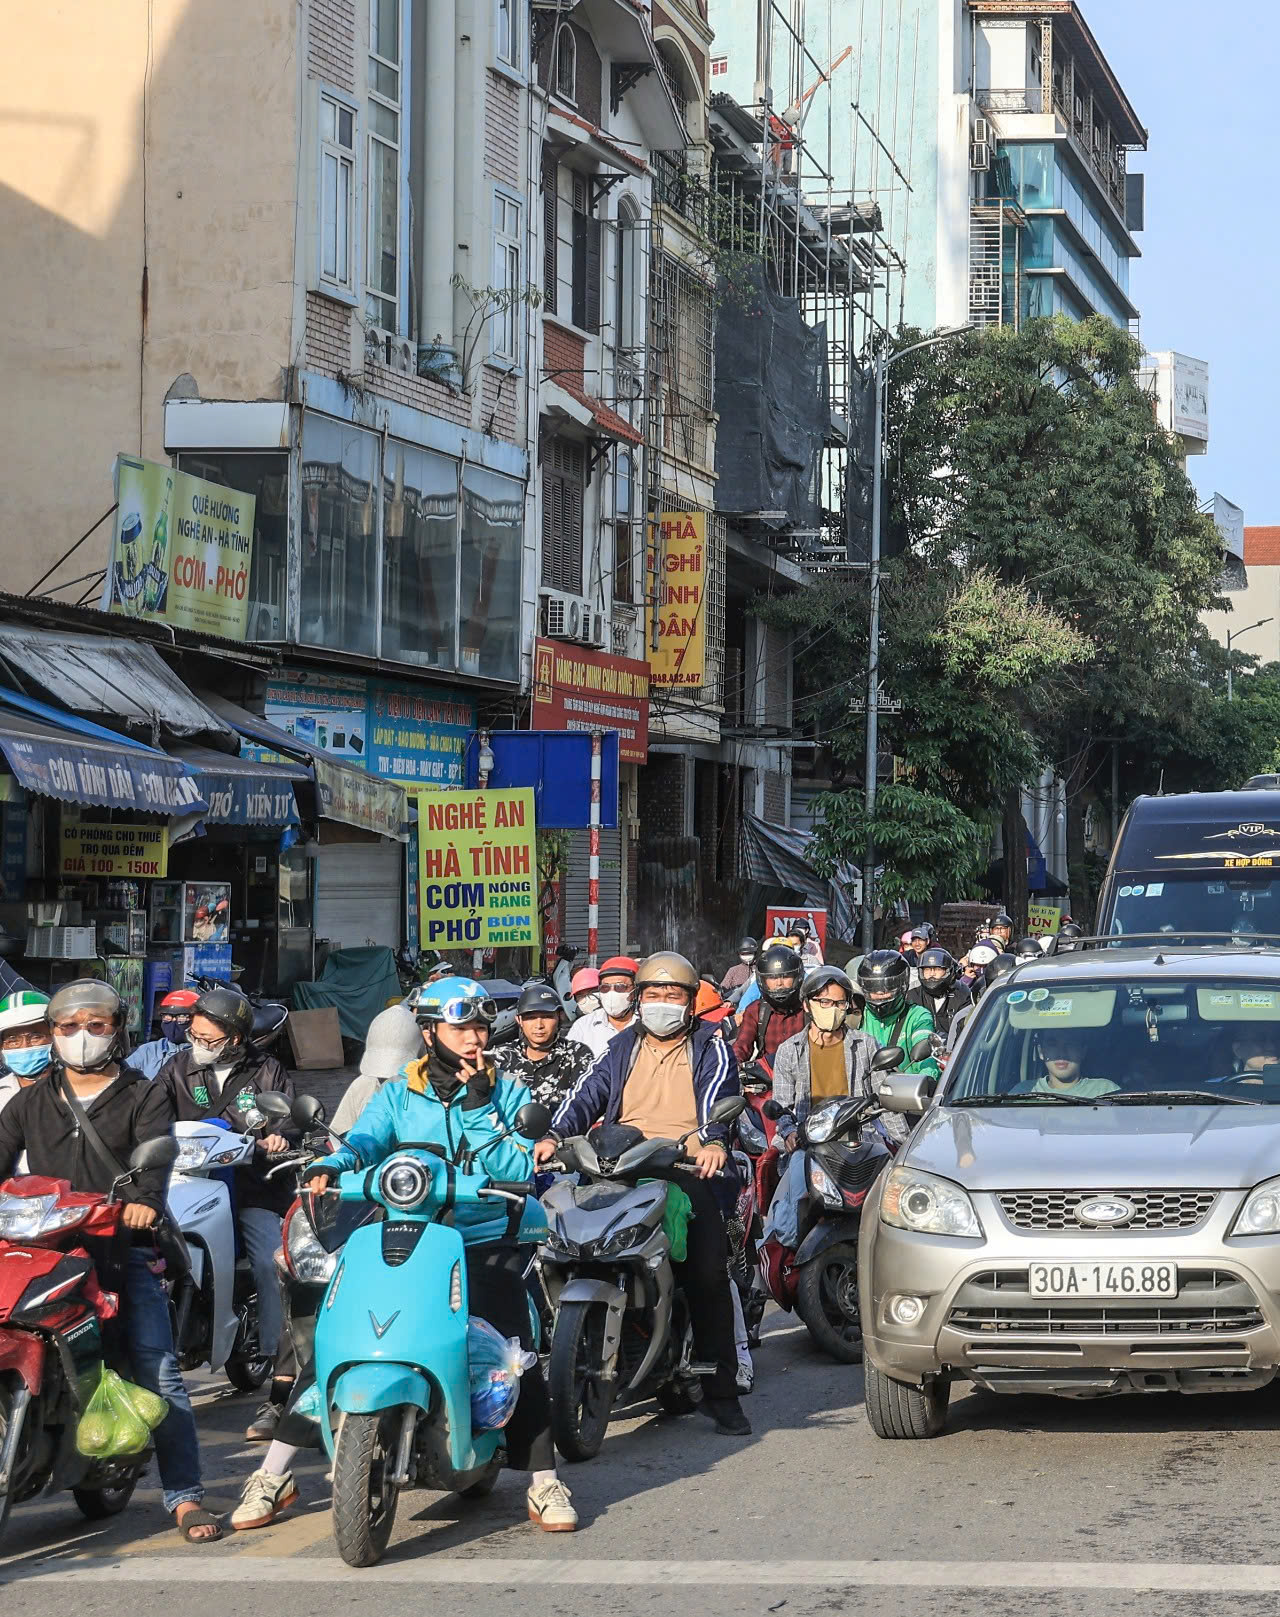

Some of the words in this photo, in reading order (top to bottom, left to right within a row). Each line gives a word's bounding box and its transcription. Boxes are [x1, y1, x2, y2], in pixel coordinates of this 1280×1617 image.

[192, 495, 209, 515] QUÊ
[210, 500, 240, 524] HƯƠNG
[177, 518, 200, 546] NGHỆ
[201, 525, 213, 544] AN
[218, 528, 229, 548] HÀ
[231, 531, 250, 554] TĨNH
[174, 554, 206, 592] CƠM
[216, 561, 248, 600] PHỞ
[556, 653, 573, 685] VÀNG
[573, 661, 586, 692] BẠC
[48, 757, 78, 792] CƠM
[428, 796, 486, 834] NGHỆ
[494, 800, 525, 828] AN
[64, 827, 77, 839] CÓ
[81, 827, 113, 840] PHÒNG
[116, 831, 135, 842] CHO
[138, 831, 161, 843] THUÊ
[1241, 825, 1262, 833] VIP
[102, 844, 120, 855] QUA
[123, 844, 145, 857] ĐÊM
[426, 842, 461, 878] HÀ
[469, 840, 530, 876] TĨNH
[1224, 859, 1235, 867] XE
[1235, 858, 1251, 867] HỢP
[1252, 856, 1273, 866] ĐỒNG
[64, 856, 86, 872] GIÁ
[92, 860, 113, 873] 100
[127, 860, 160, 875] 150K
[426, 882, 485, 909] CƠM
[488, 880, 531, 893] NÓNG
[489, 895, 531, 908] RANG
[428, 908, 483, 942] PHỞ
[487, 914, 530, 927] BÚN
[773, 912, 819, 937] NÀ
[488, 926, 532, 942] MIẾN
[1034, 1266, 1171, 1293] 30A-146.88
[67, 1323, 94, 1342] HONDA
